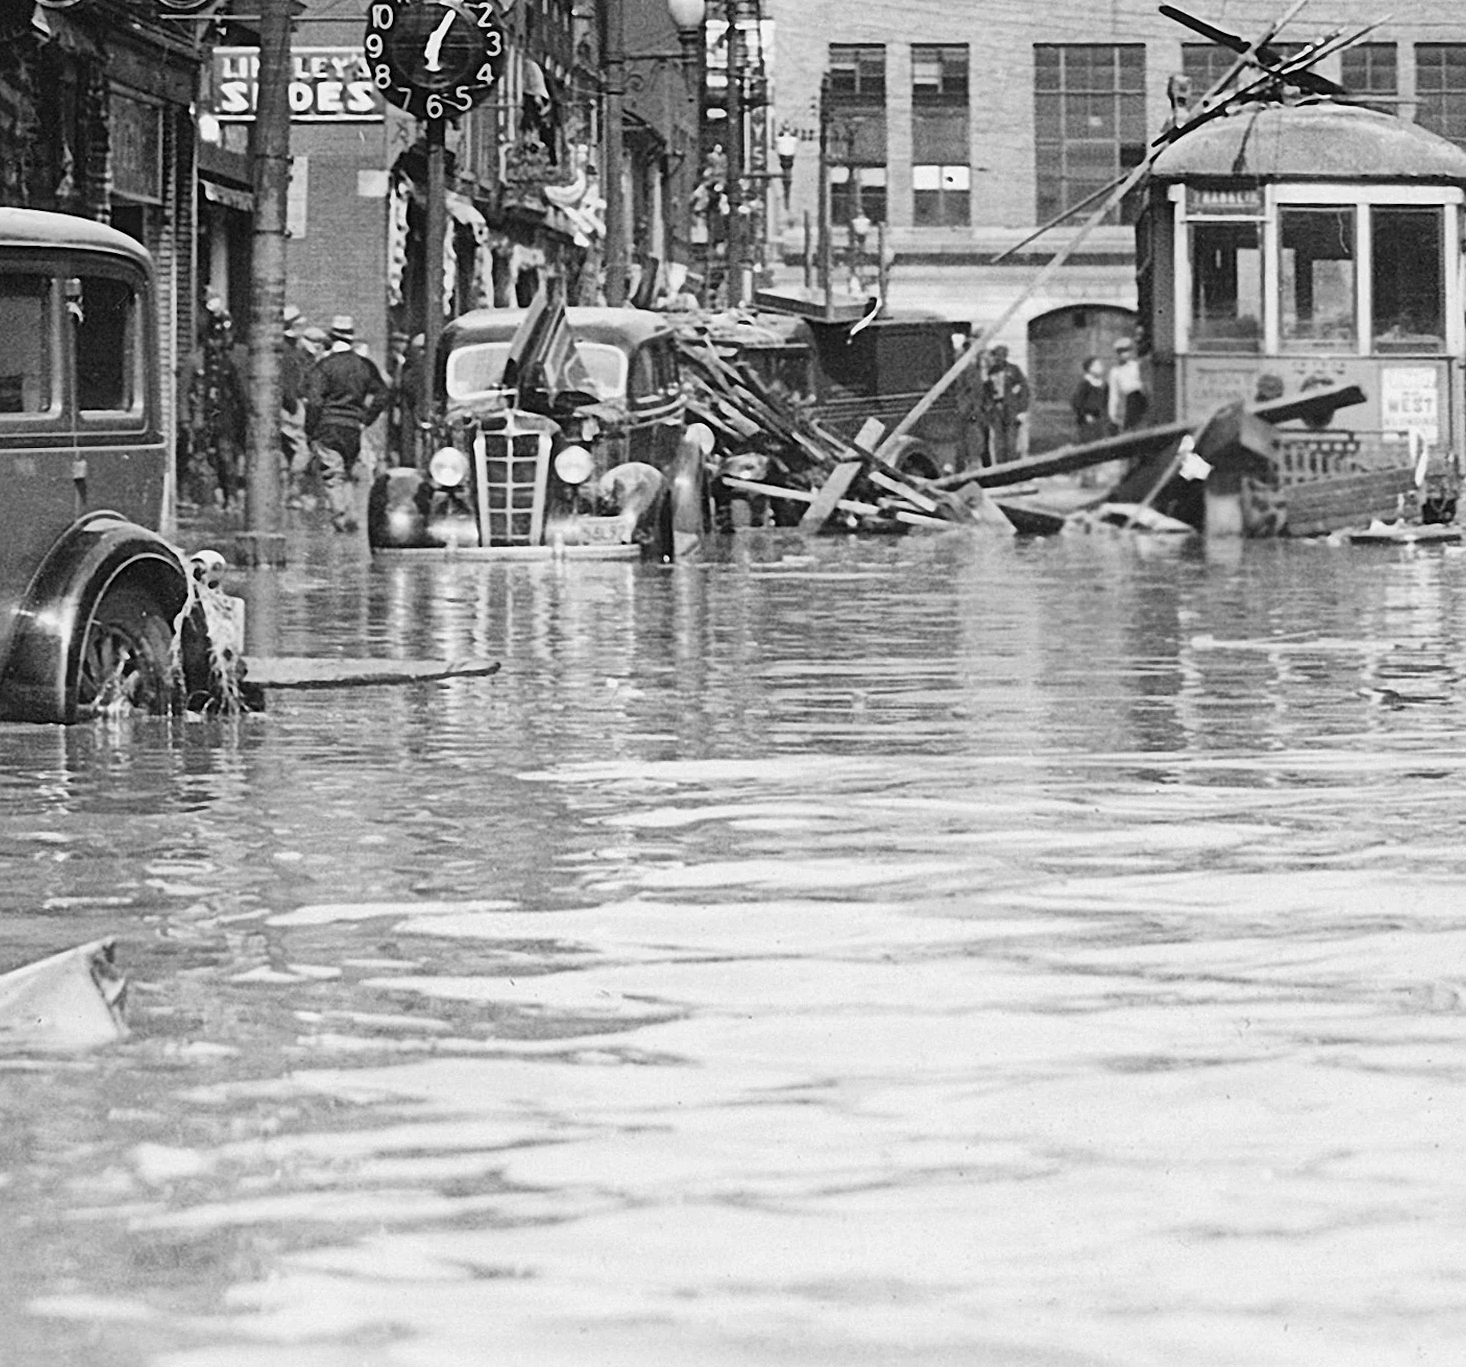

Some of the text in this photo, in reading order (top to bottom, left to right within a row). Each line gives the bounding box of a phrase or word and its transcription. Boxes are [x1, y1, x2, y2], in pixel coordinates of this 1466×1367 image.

[371, 3, 394, 30] 10
[477, 1, 493, 28] 2
[365, 33, 383, 58] 9
[486, 31, 502, 57] 3
[222, 54, 373, 79] LILEY'S
[374, 63, 392, 90] 8
[476, 63, 495, 85] 4
[397, 86, 412, 111] 7
[426, 94, 444, 119] 6
[455, 86, 473, 112] 5
